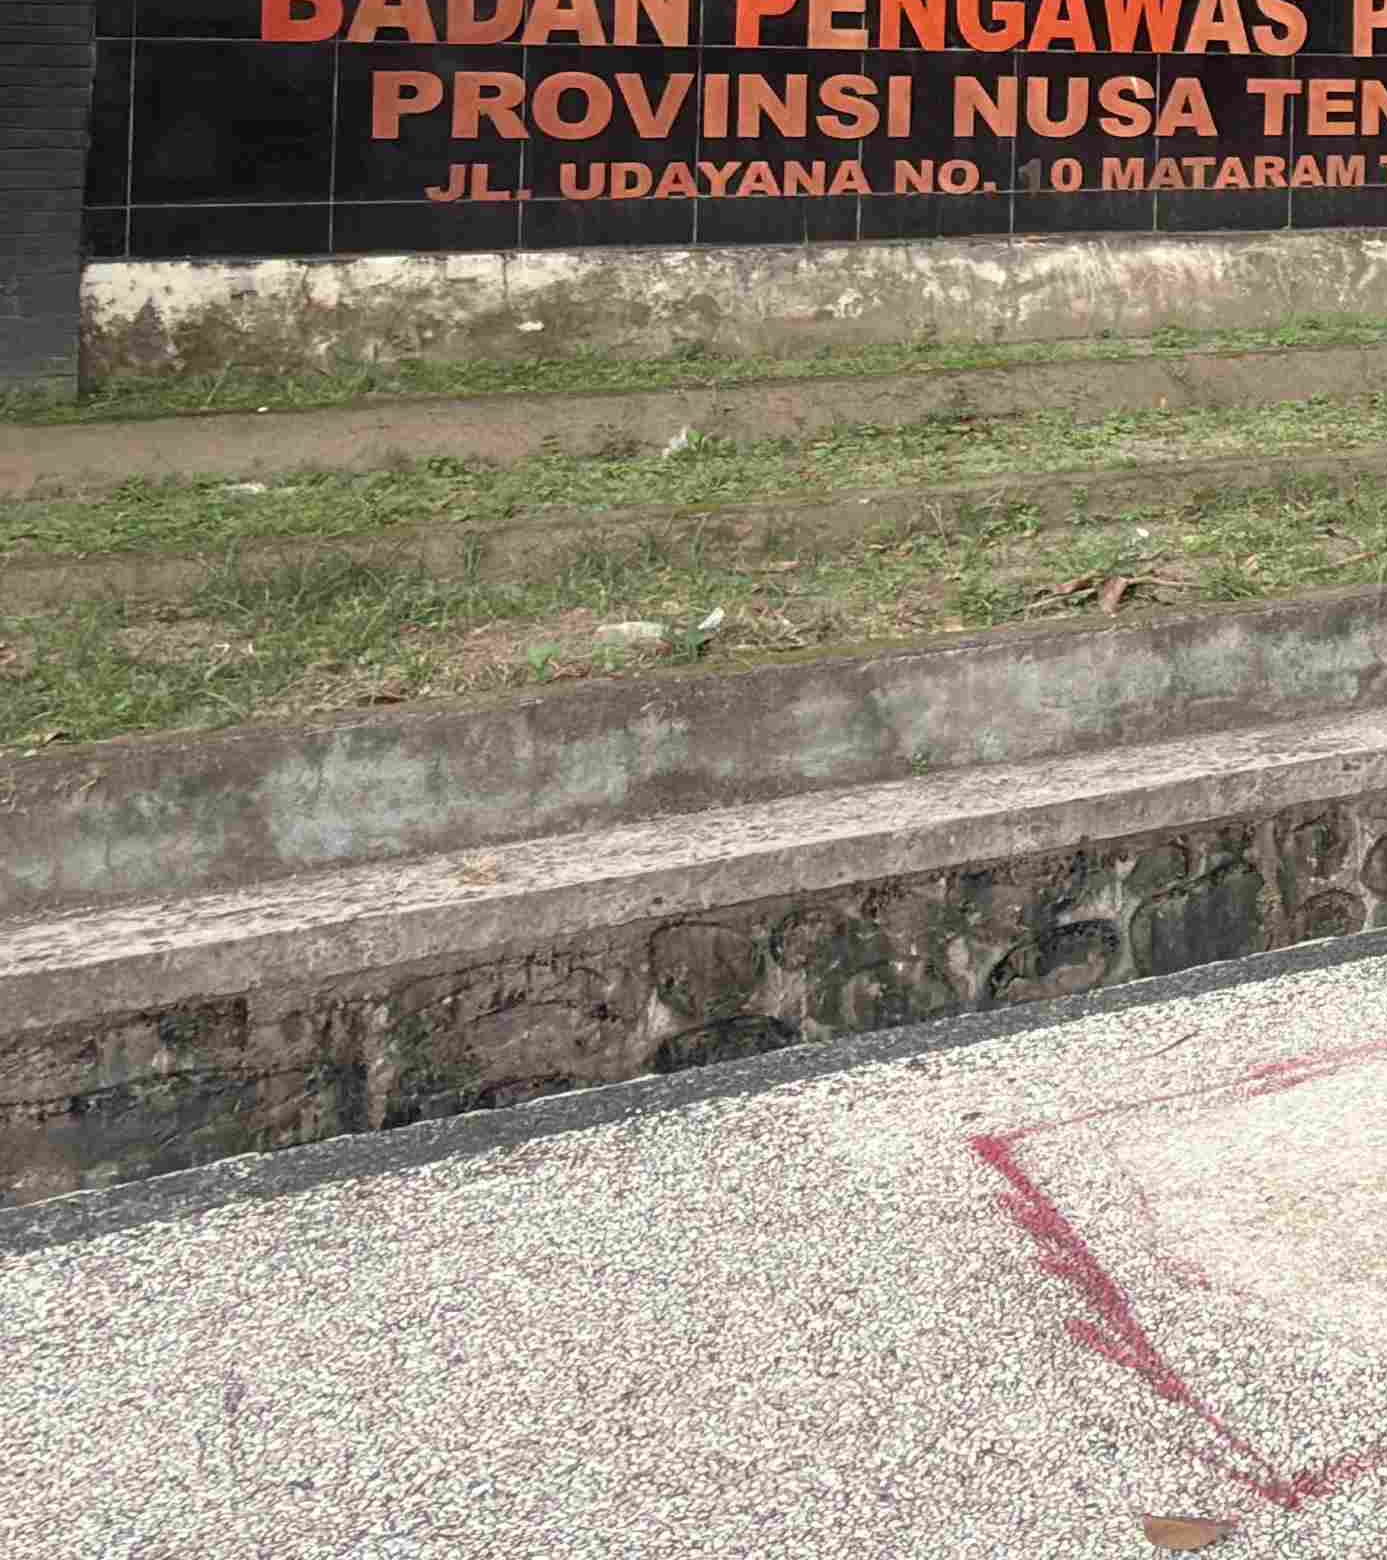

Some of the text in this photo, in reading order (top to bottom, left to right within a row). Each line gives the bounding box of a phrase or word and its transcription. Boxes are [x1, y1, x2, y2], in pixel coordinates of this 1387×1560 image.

[371, 71, 914, 140] PROVINSI
[952, 75, 1217, 138] NUSA
[424, 162, 531, 202] JL.
[559, 159, 873, 201] UDAYANA
[893, 158, 998, 195] NO.
[1018, 157, 1083, 193] 10
[1102, 154, 1367, 193] MATARAM
